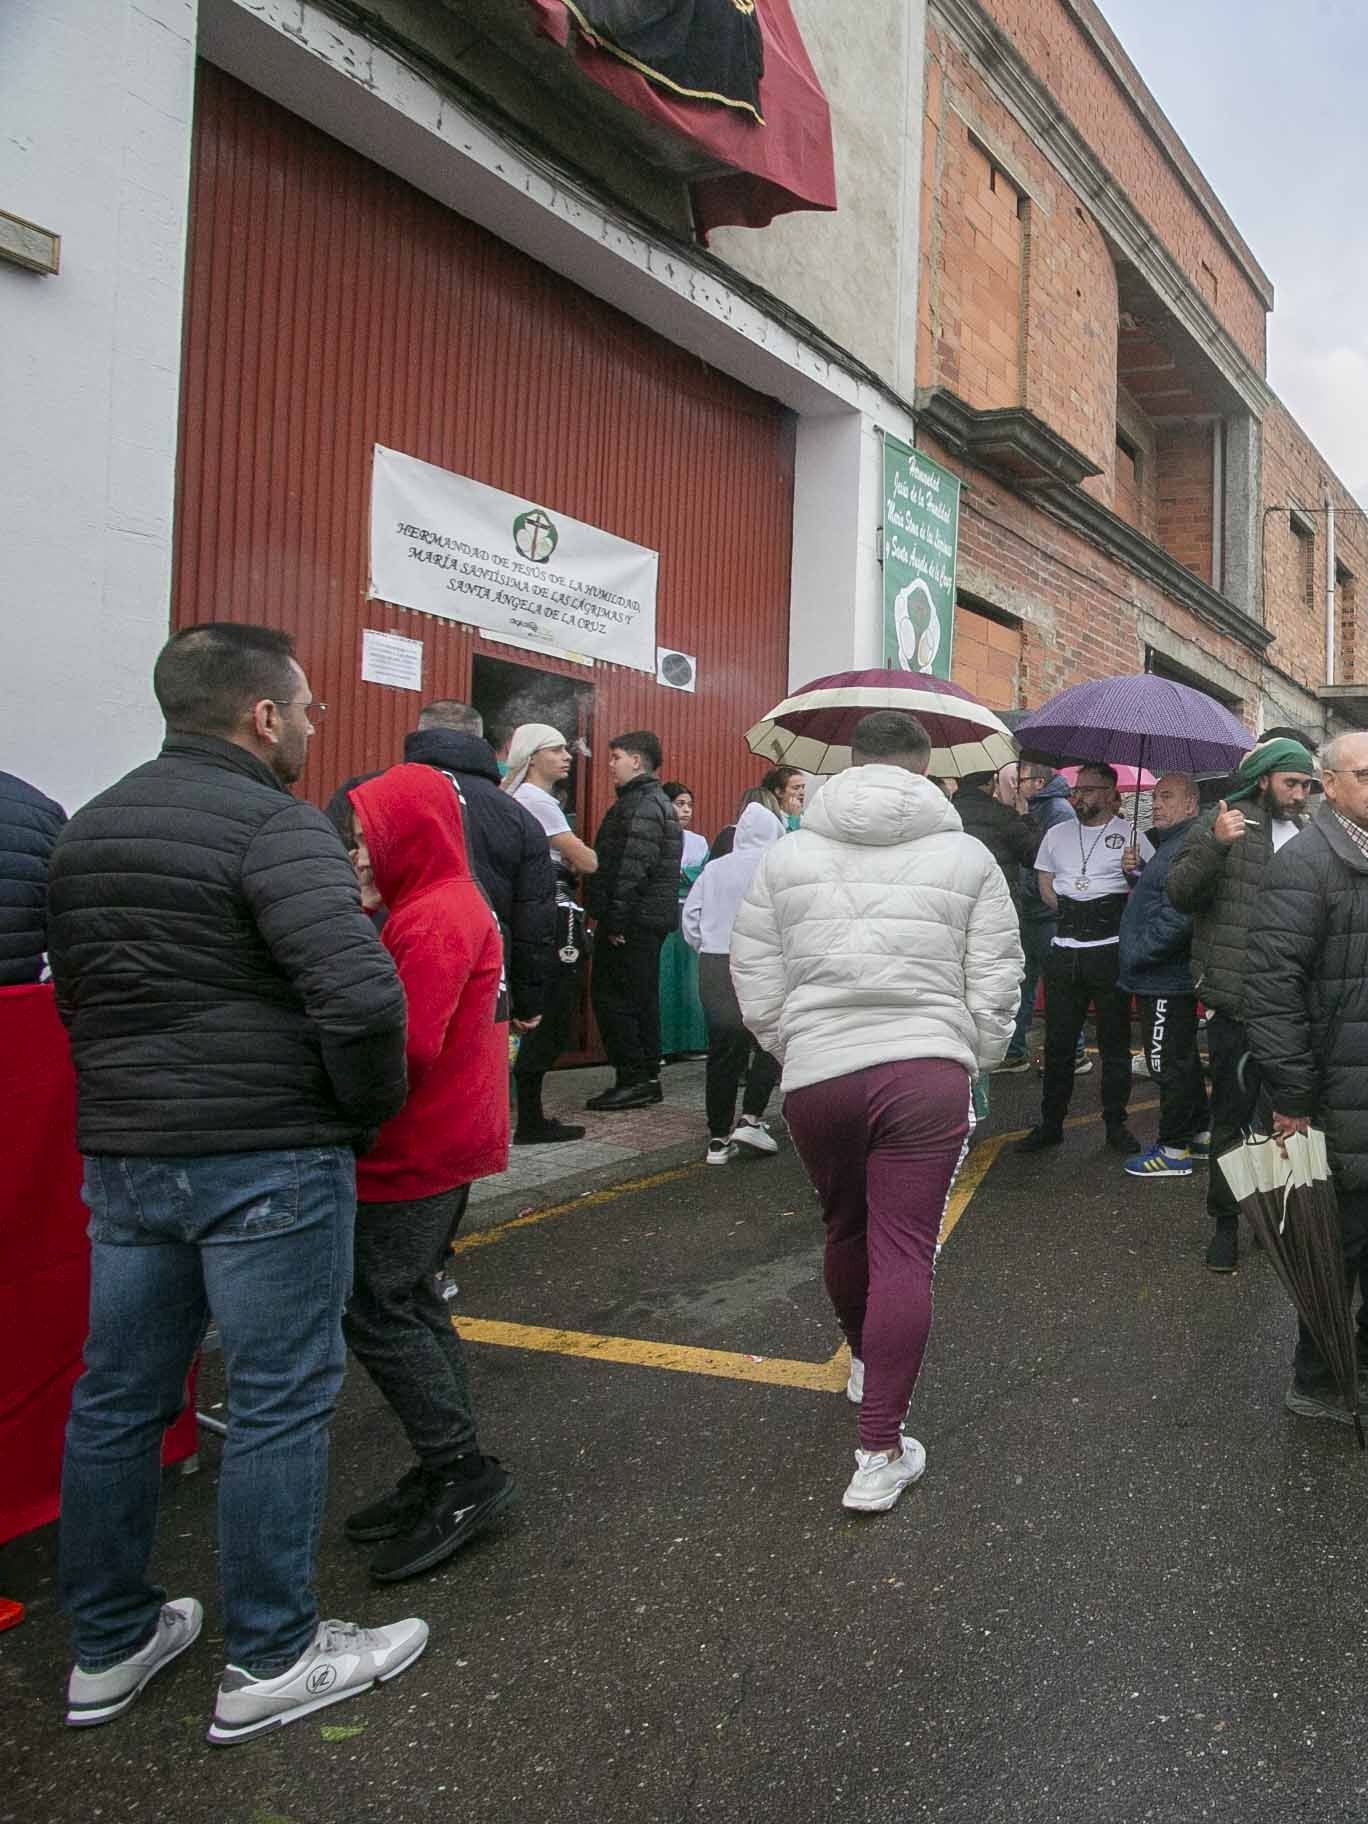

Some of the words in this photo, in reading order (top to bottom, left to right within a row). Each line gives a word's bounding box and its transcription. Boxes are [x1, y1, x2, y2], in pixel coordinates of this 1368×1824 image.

[397, 522, 490, 561] HERMANDAD
[491, 554, 510, 569] DE
[549, 574, 566, 586] DE
[568, 580, 582, 592] LA
[584, 585, 641, 613] HUMILDAD,
[408, 547, 458, 571] MARÍA
[460, 562, 529, 593] SANTÍSIMA
[531, 585, 549, 598] DE
[550, 591, 572, 607] LAS
[571, 598, 624, 625] LÁGRIMAS
[625, 615, 634, 624] Y
[447, 578, 490, 599] SANTA
[491, 590, 542, 615] ÁNGELA
[544, 607, 560, 620] DE
[561, 613, 575, 626] LA
[577, 618, 607, 634] CRUZ
[1151, 998, 1168, 1073] GIVOVA
